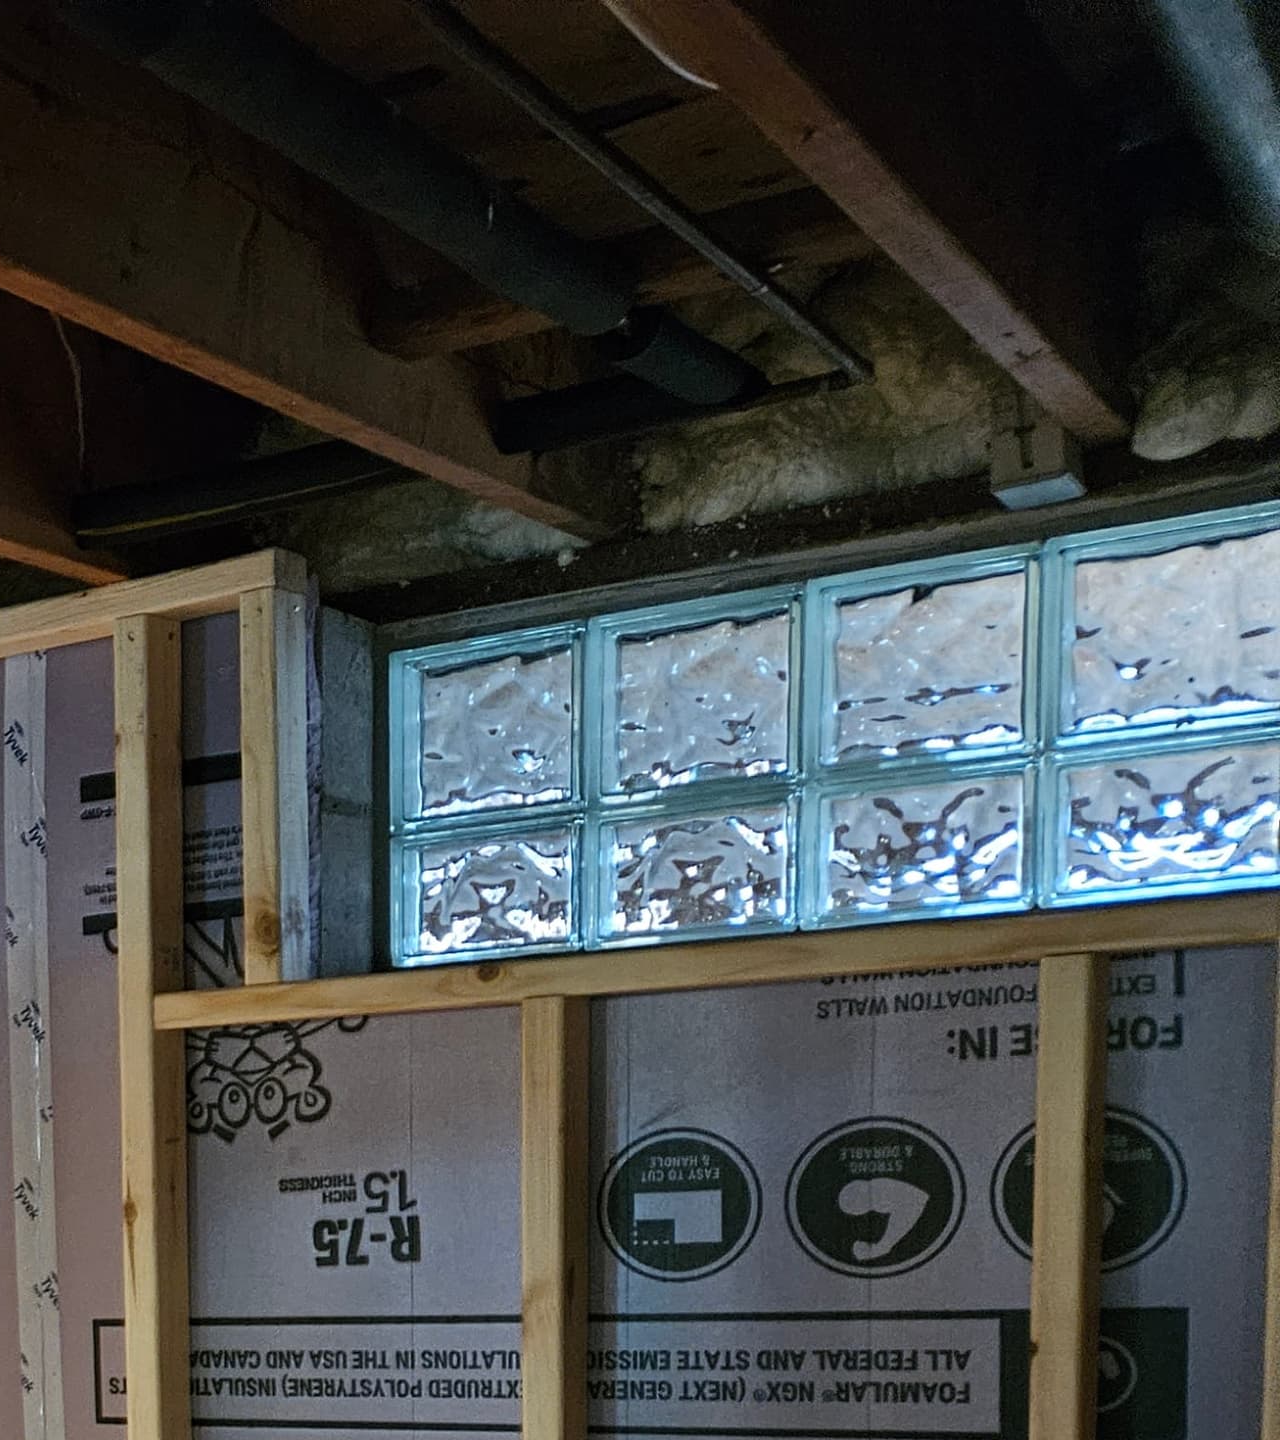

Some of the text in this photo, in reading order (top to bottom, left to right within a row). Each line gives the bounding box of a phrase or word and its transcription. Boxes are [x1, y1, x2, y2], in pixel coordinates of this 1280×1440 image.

[816, 996, 887, 1020] WALLS
[1107, 1013, 1183, 1051] FOR
[363, 1169, 417, 1213] 1.5
[313, 1215, 421, 1268] R-7.5
[421, 1350, 520, 1369] ULATIONS
